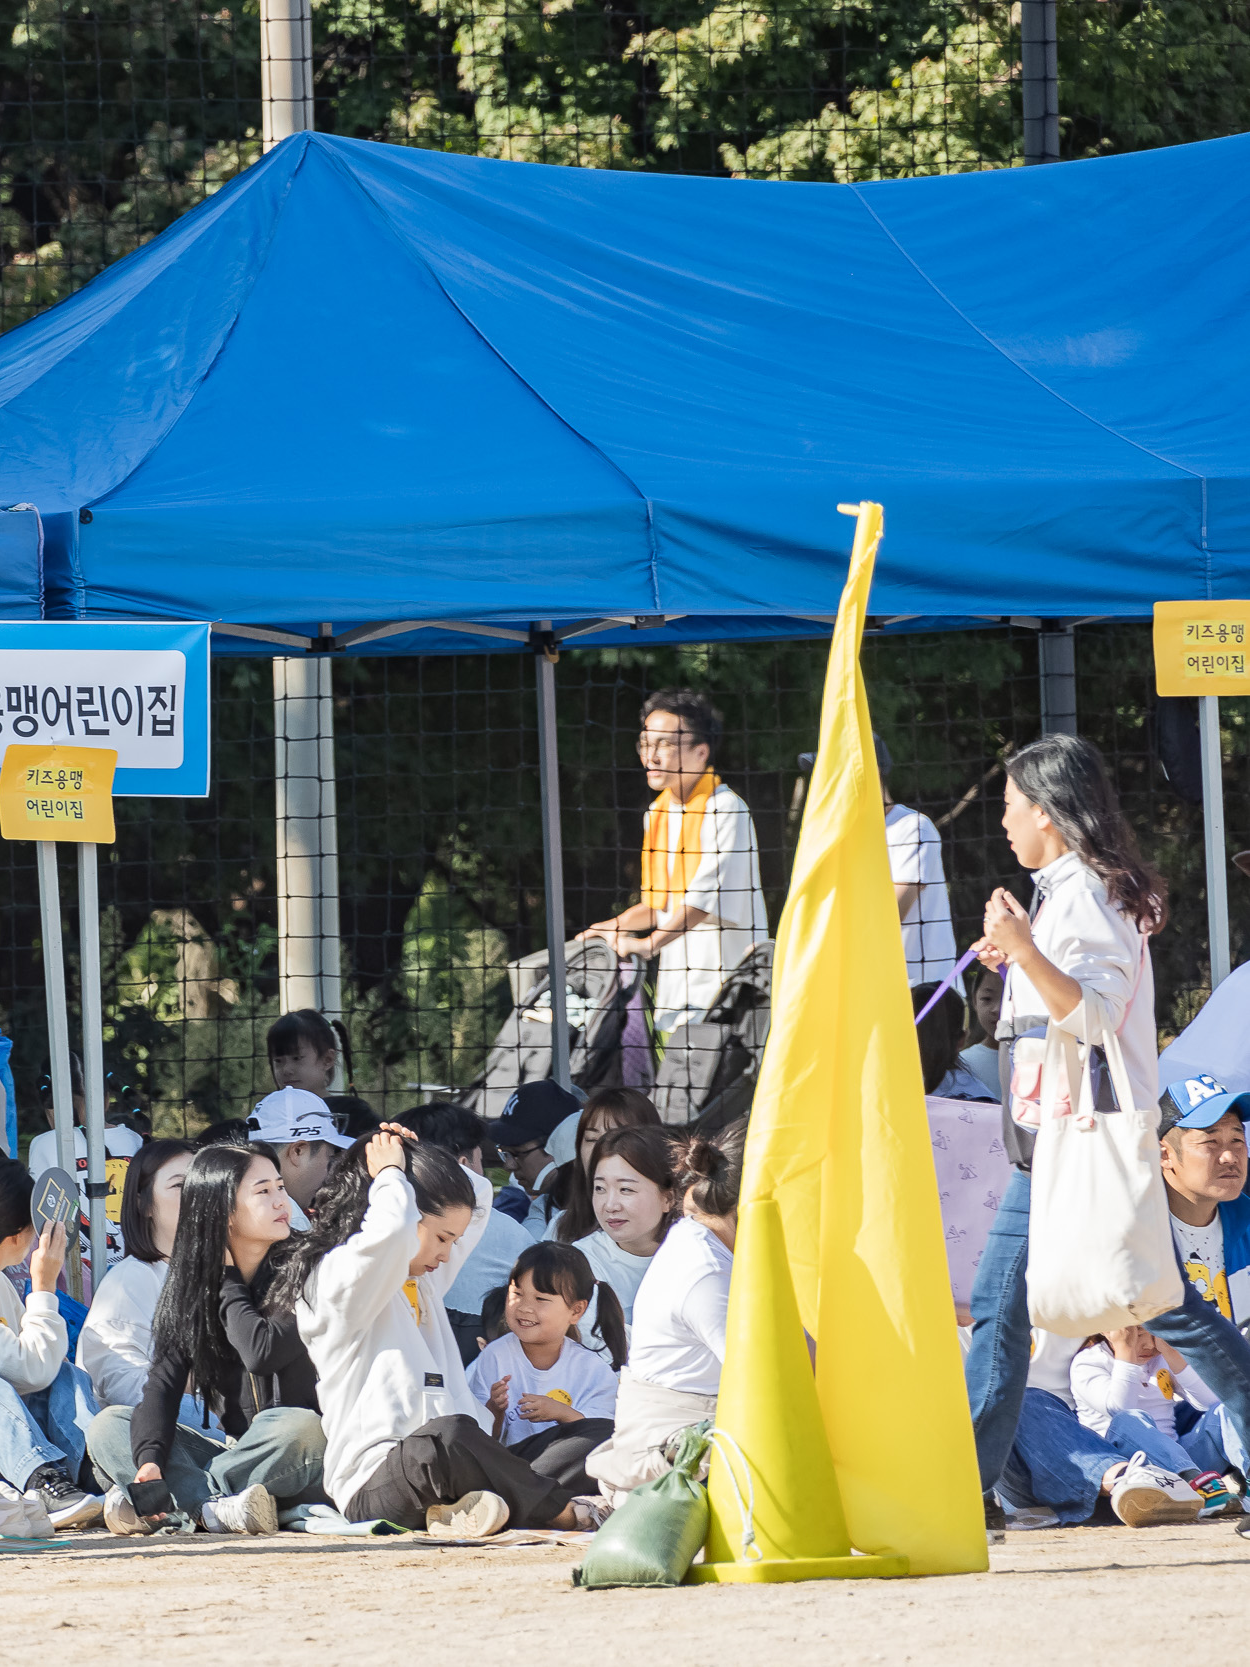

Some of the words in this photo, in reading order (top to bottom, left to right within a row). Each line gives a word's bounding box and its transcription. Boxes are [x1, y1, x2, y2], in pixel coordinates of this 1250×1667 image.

[1187, 624, 1245, 643] 키즈용맹
[1187, 655, 1245, 674] 어린이집
[26, 768, 84, 790] 키즈용맹
[26, 799, 84, 819] 어린이집
